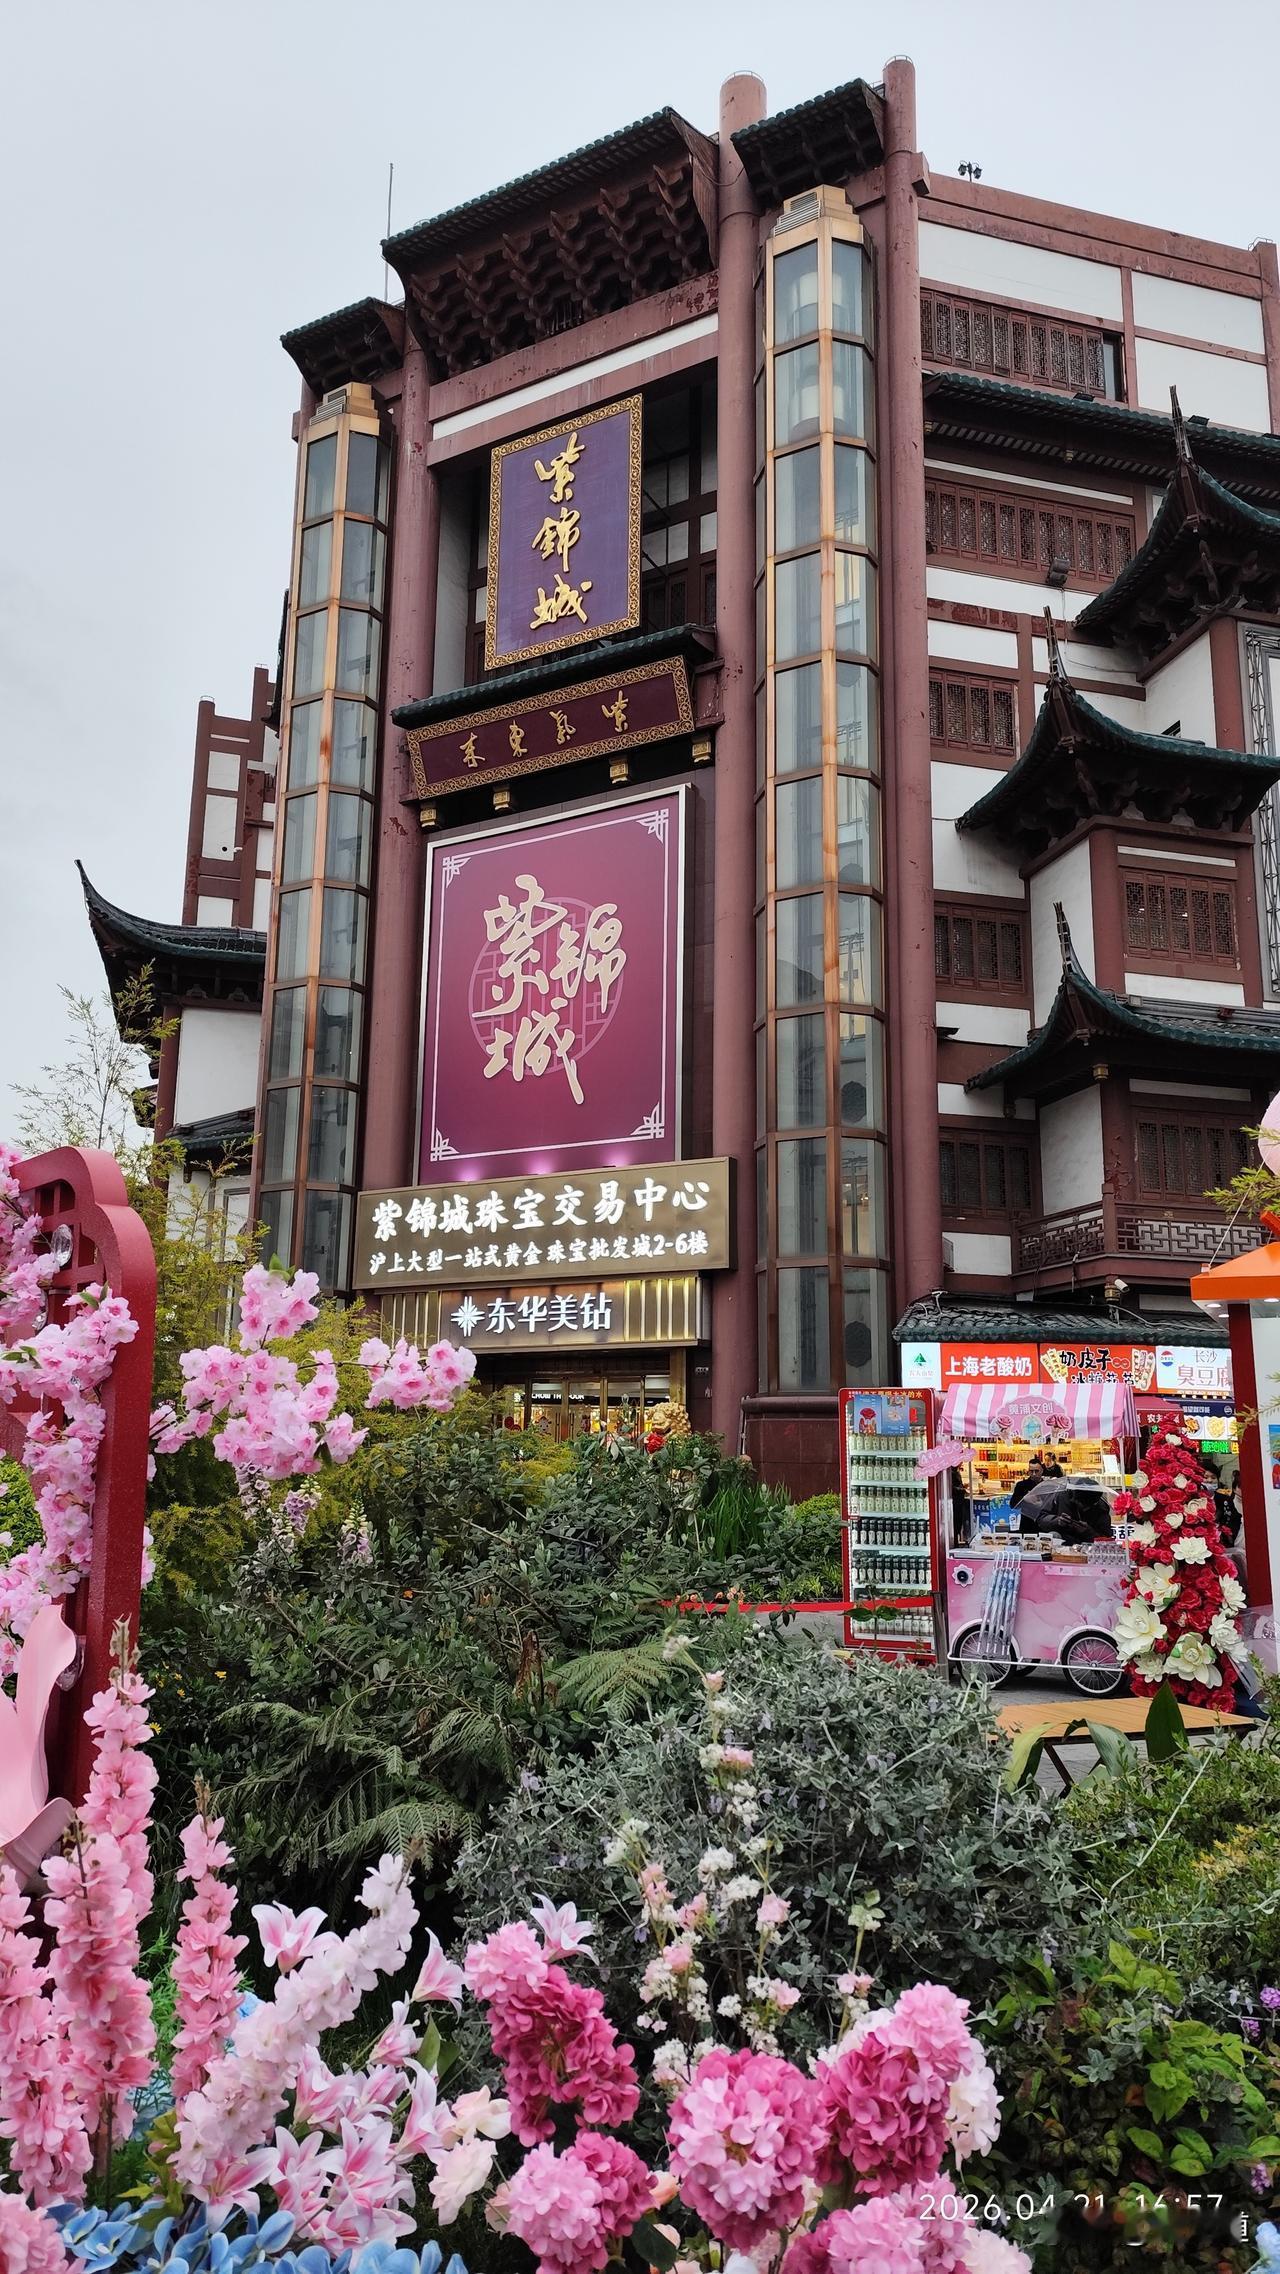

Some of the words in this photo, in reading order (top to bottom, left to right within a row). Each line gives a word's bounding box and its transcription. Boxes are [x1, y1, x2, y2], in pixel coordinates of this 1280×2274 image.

[372, 1176, 711, 1241] 紫锦城珠宝交易中心
[369, 1230, 708, 1275] 沪上大型一站式黄金珠宝批发城2-6楼
[485, 1291, 613, 1334] 东华美钻
[945, 1355, 1032, 1377] 上海老酸奶
[1059, 1347, 1112, 1371] 奶皮子
[1193, 1349, 1218, 1363] 长沙
